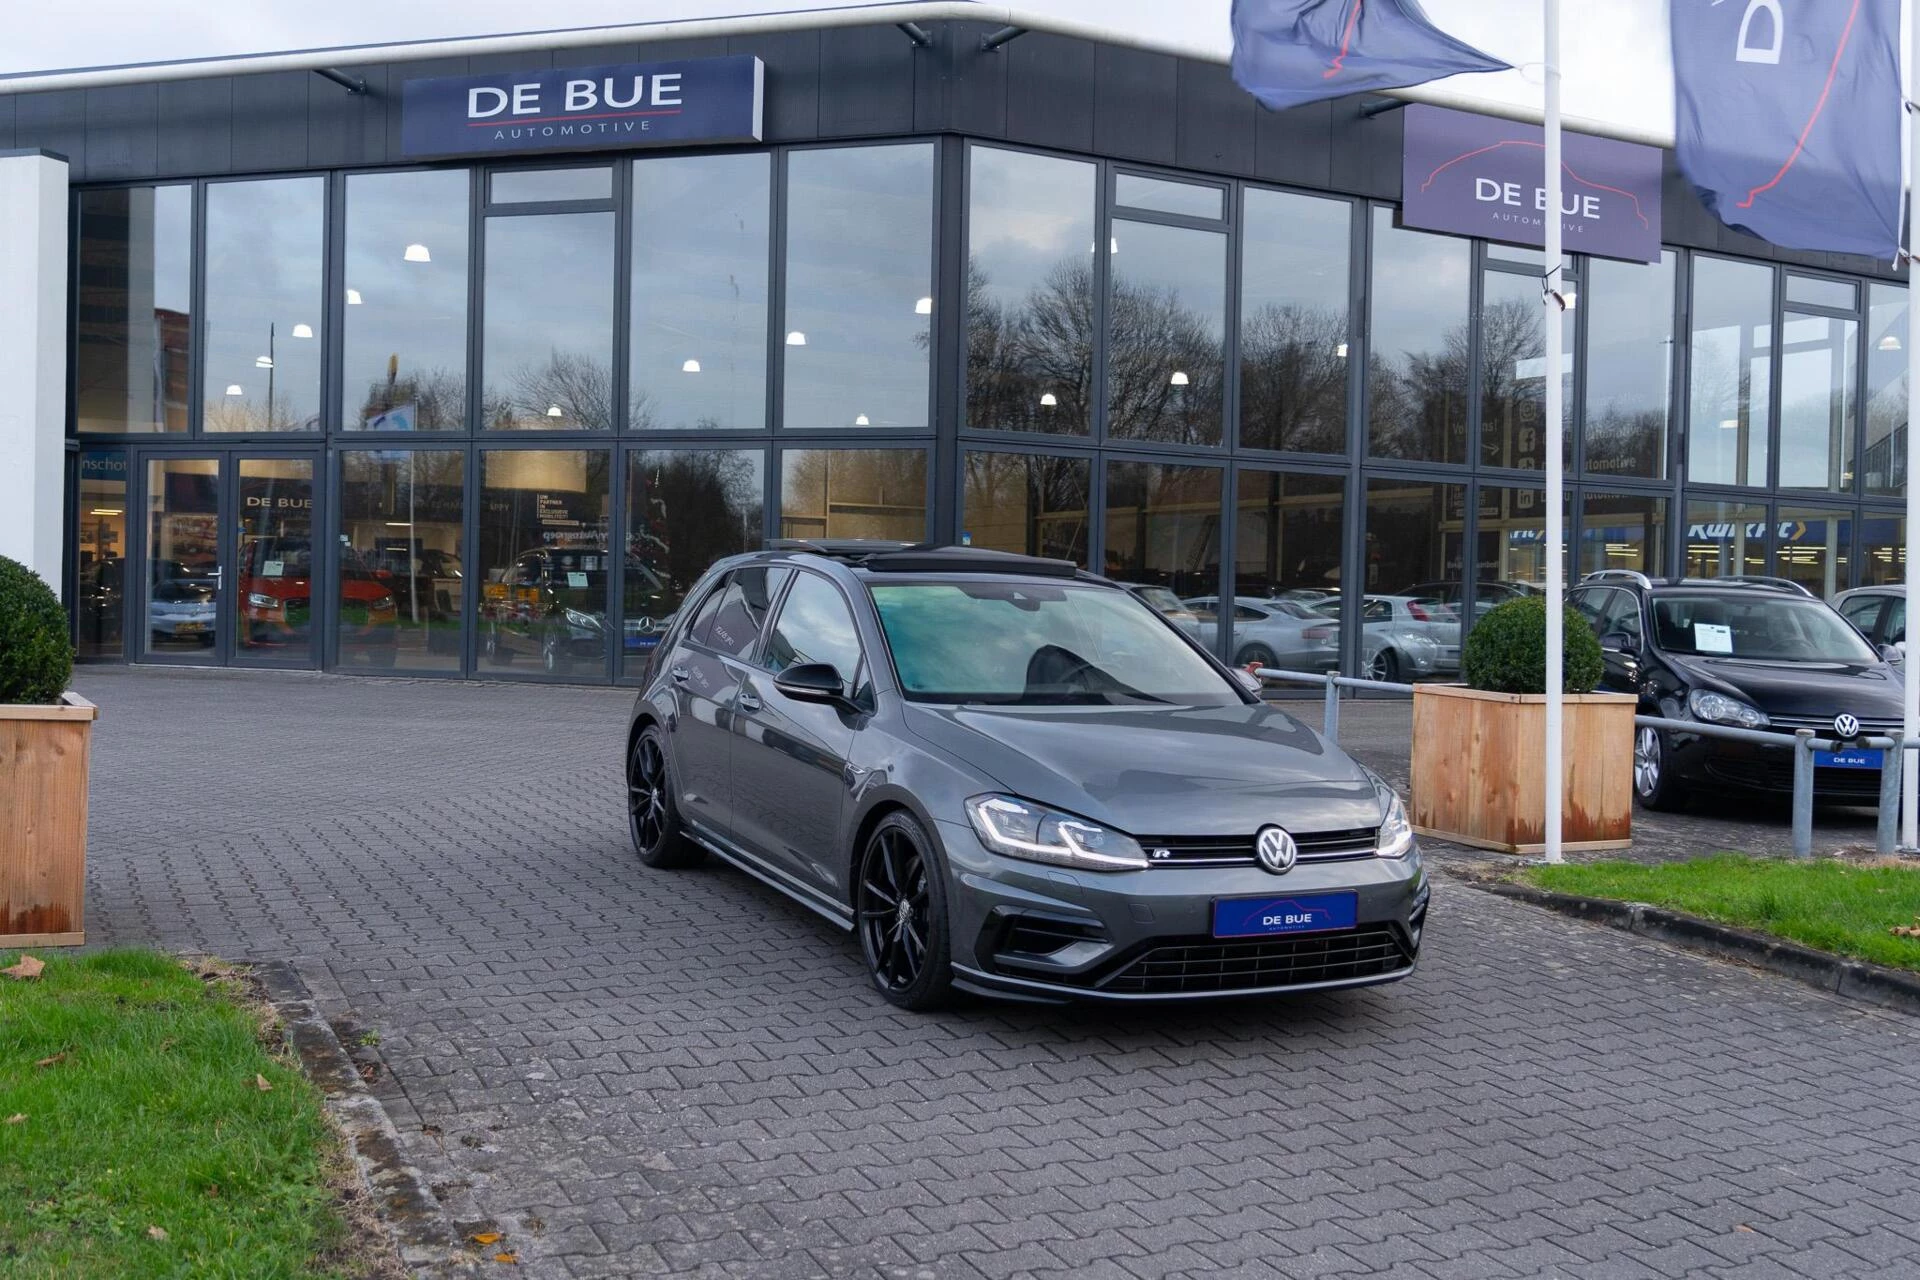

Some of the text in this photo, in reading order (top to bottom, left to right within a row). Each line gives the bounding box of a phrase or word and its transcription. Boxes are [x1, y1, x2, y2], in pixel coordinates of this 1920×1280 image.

[467, 73, 682, 118] DE BUE
[494, 120, 650, 141] AUTOMOTIVE
[1475, 177, 1522, 206] DE
[1492, 211, 1585, 234] AUTOMIVE
[1585, 454, 1637, 471] tomotive
[246, 496, 313, 509] DE BUE
[1848, 757, 1866, 765] BUE
[1263, 913, 1312, 926] DE BUE
